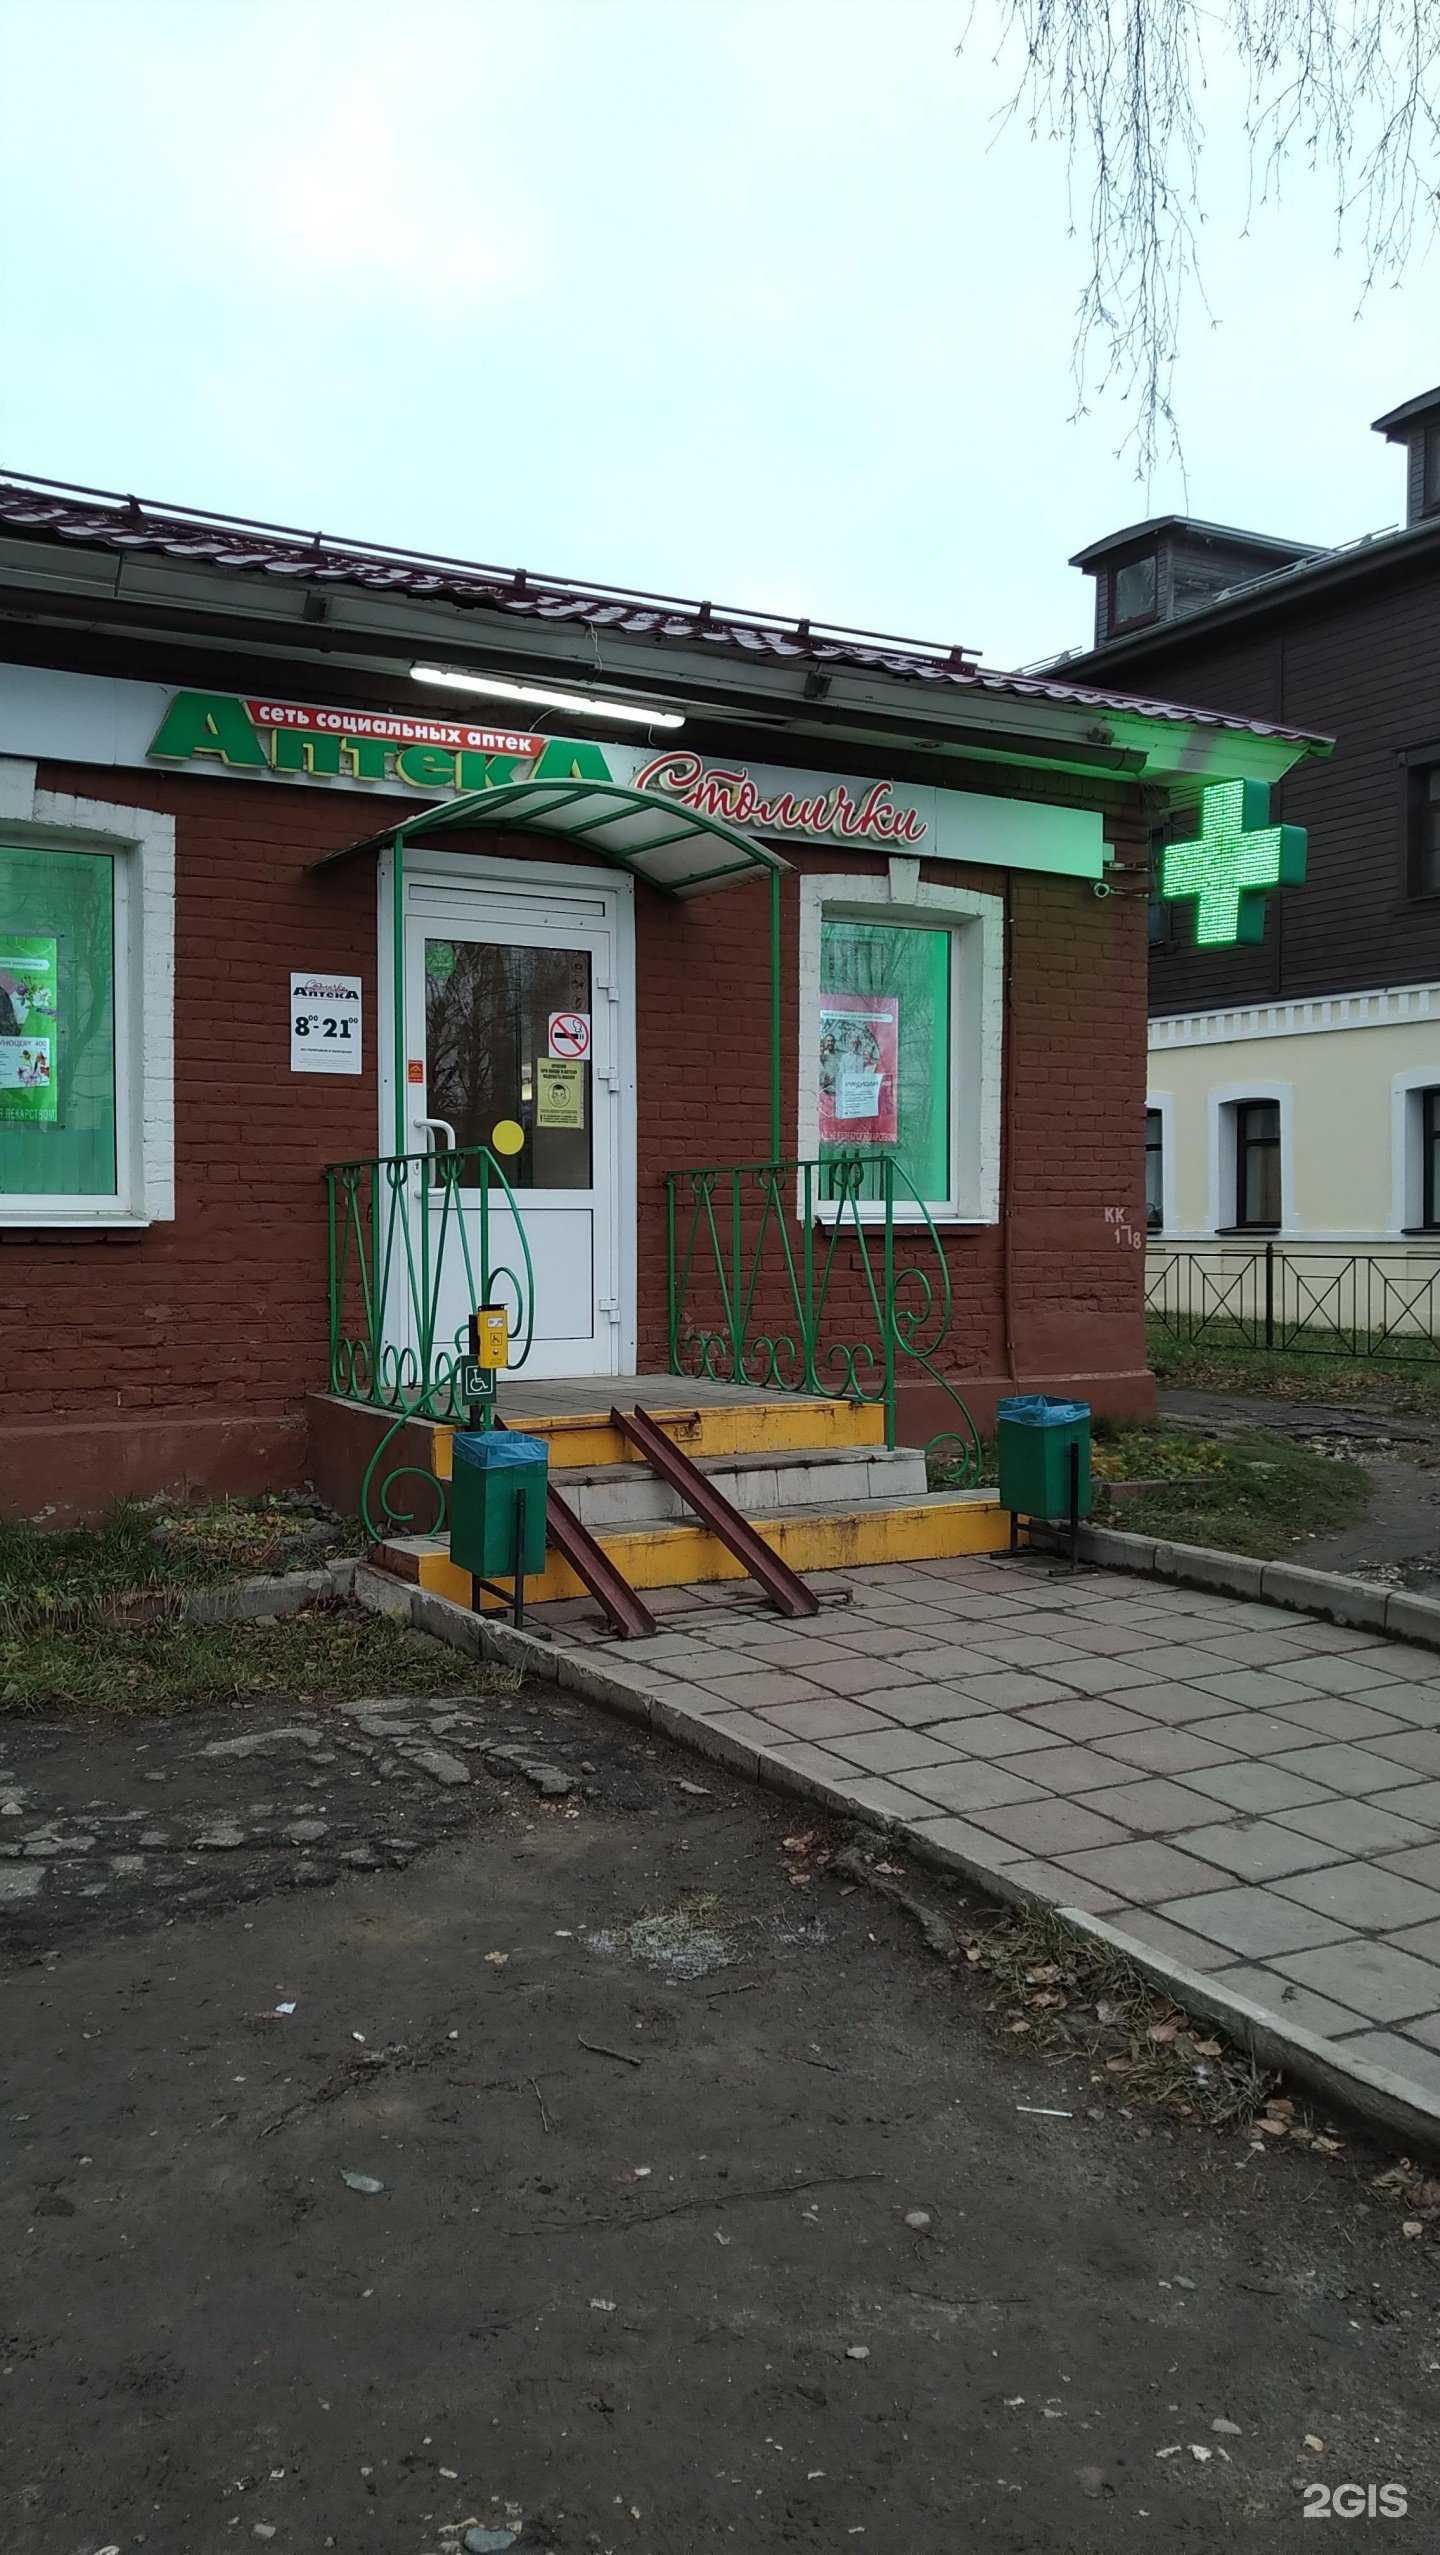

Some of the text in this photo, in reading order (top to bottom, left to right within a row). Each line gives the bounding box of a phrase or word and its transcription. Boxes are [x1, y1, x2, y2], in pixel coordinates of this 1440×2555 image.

[259, 705, 532, 752] сеть социальных аптек
[635, 751, 927, 844] Столички
